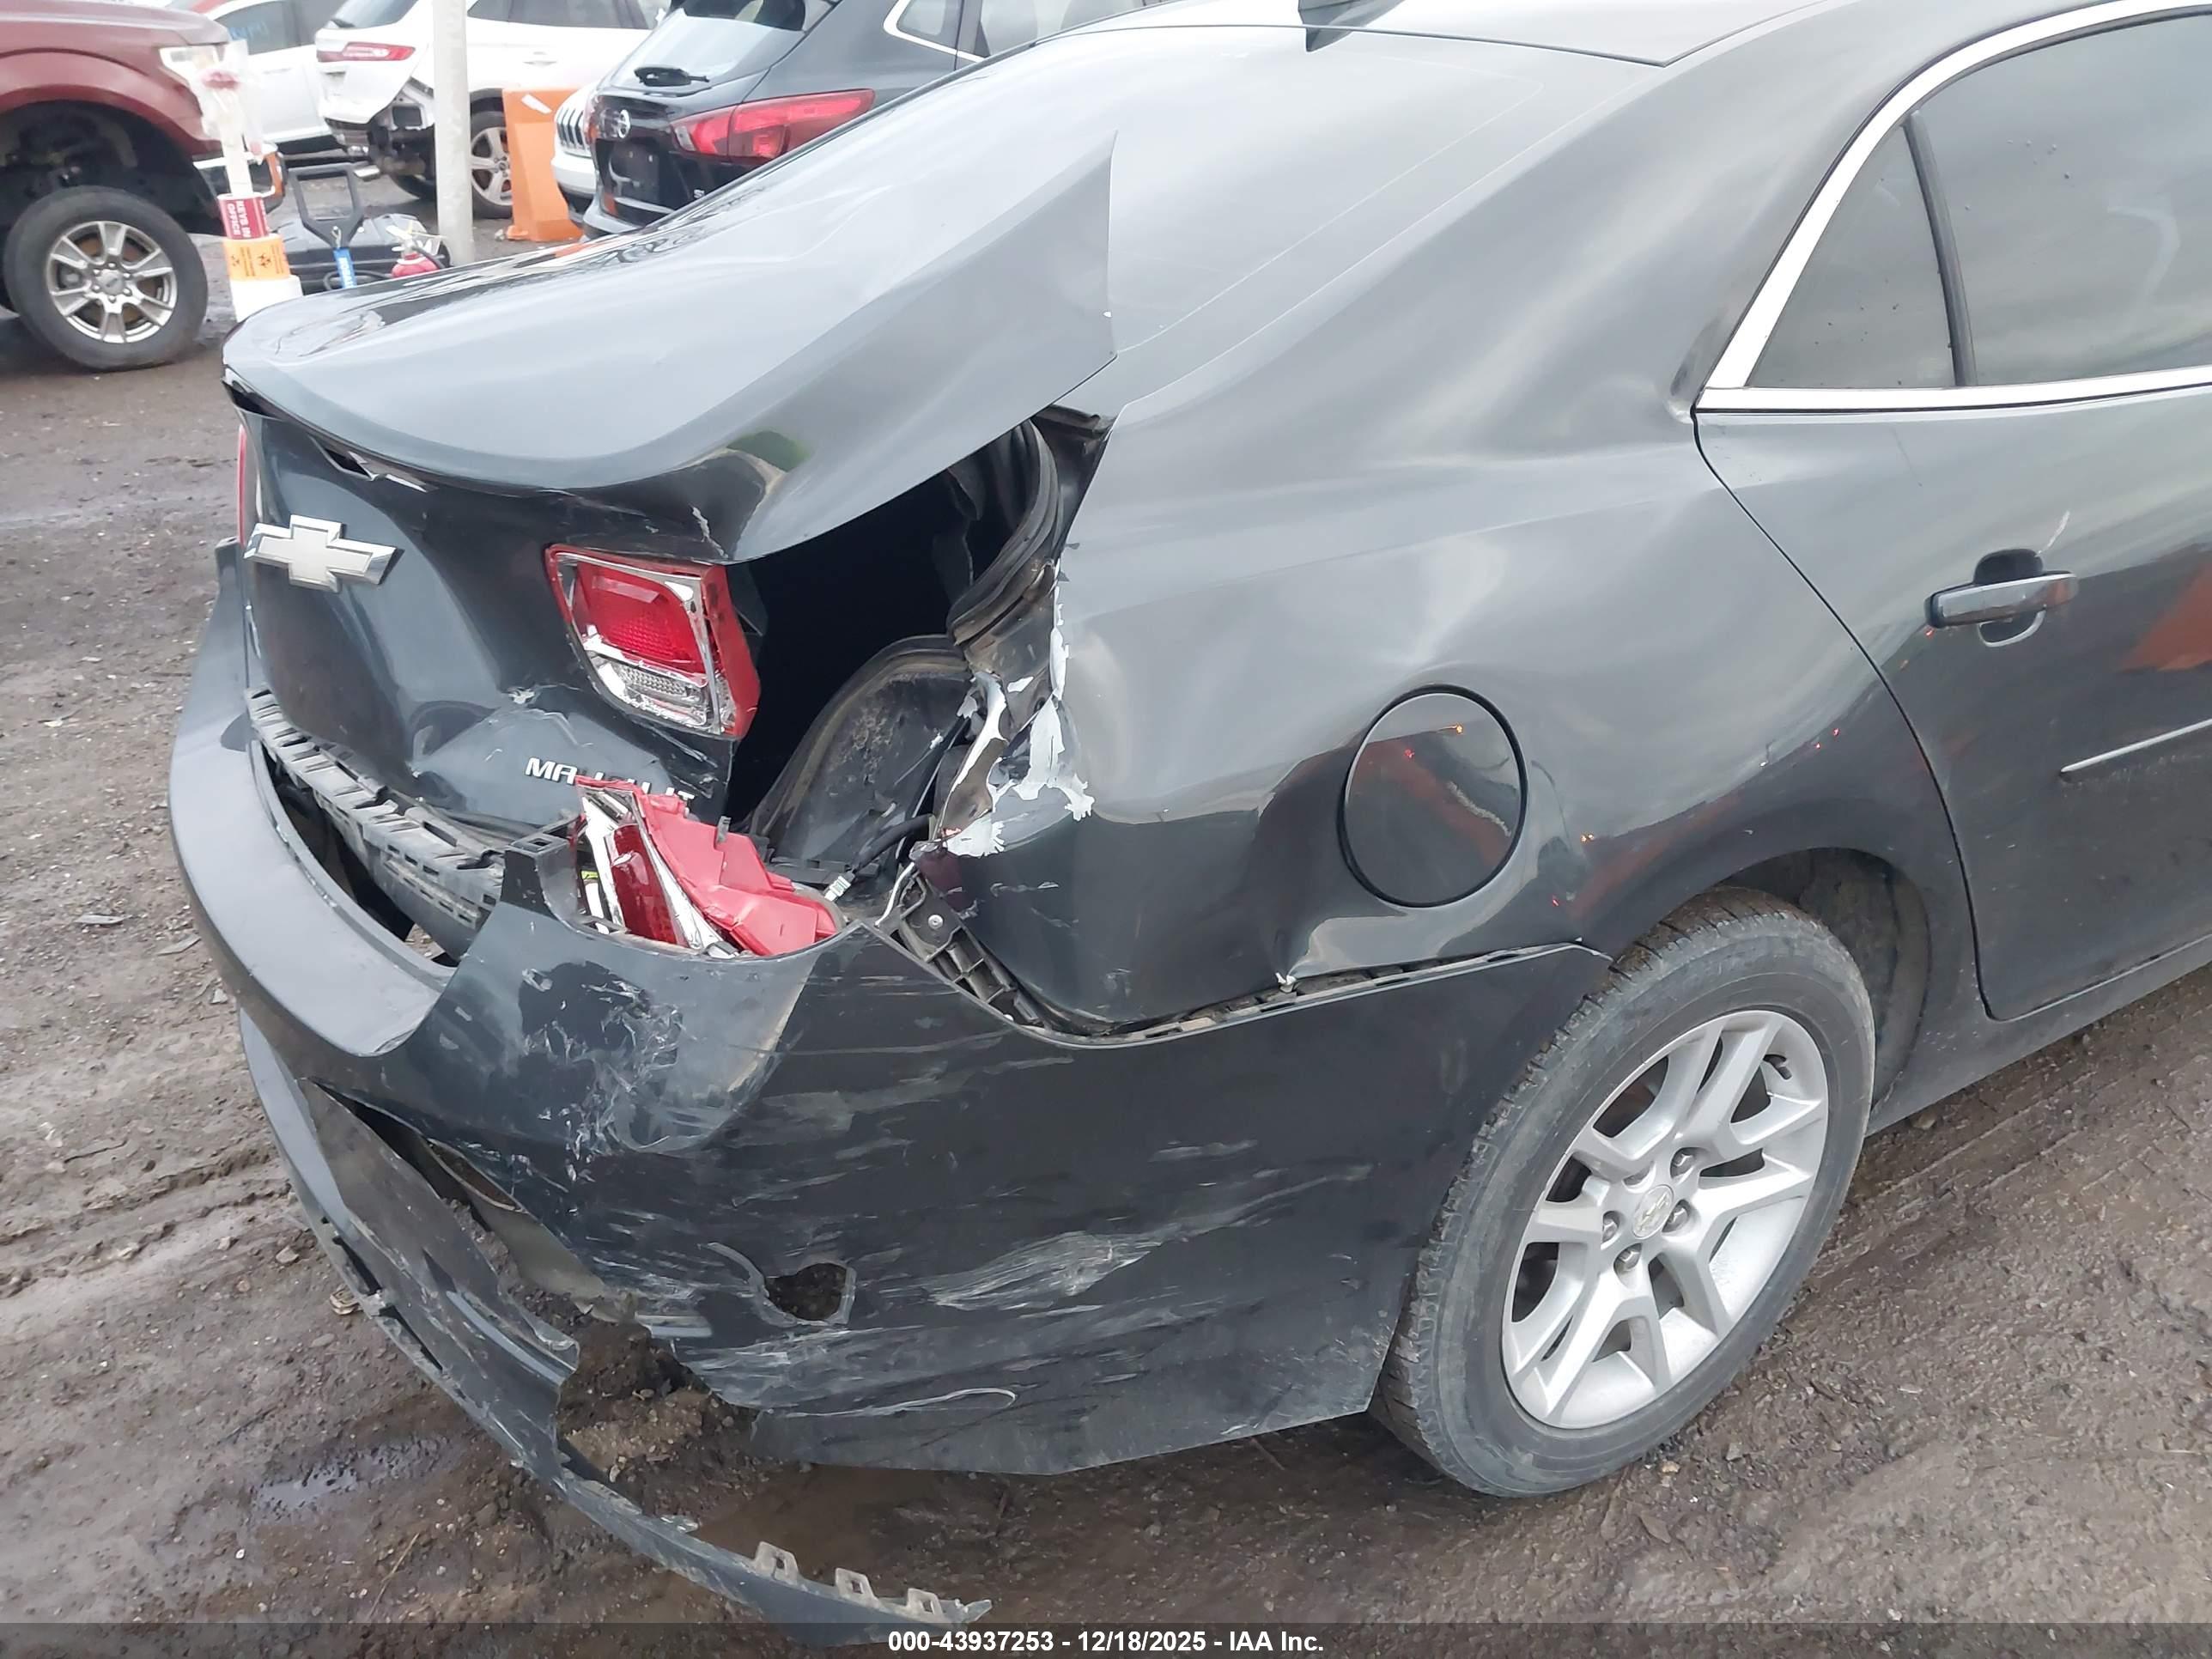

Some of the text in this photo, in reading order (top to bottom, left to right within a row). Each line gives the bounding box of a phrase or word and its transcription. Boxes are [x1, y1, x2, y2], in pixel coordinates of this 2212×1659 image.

[227, 203, 241, 236] OFFICE
[236, 200, 249, 226] KEYS
[241, 227, 252, 238] IN
